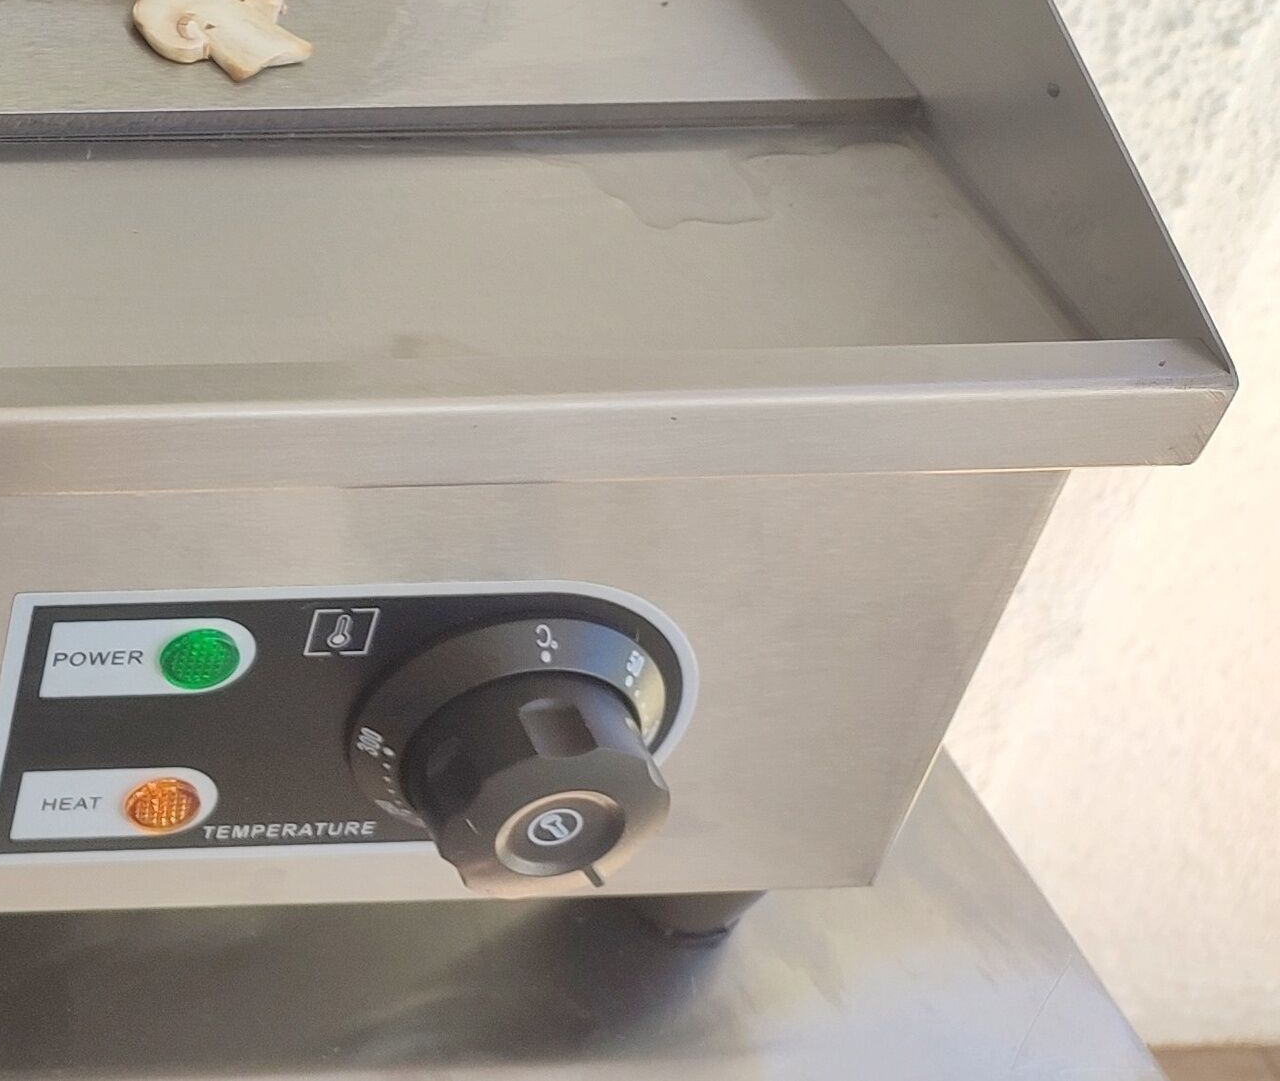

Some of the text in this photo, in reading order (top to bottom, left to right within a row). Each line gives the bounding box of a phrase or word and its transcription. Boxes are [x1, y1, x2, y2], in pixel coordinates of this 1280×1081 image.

[52, 650, 144, 667] POWER
[41, 796, 103, 812] HEAT
[202, 820, 377, 840] TEMPERATURE
